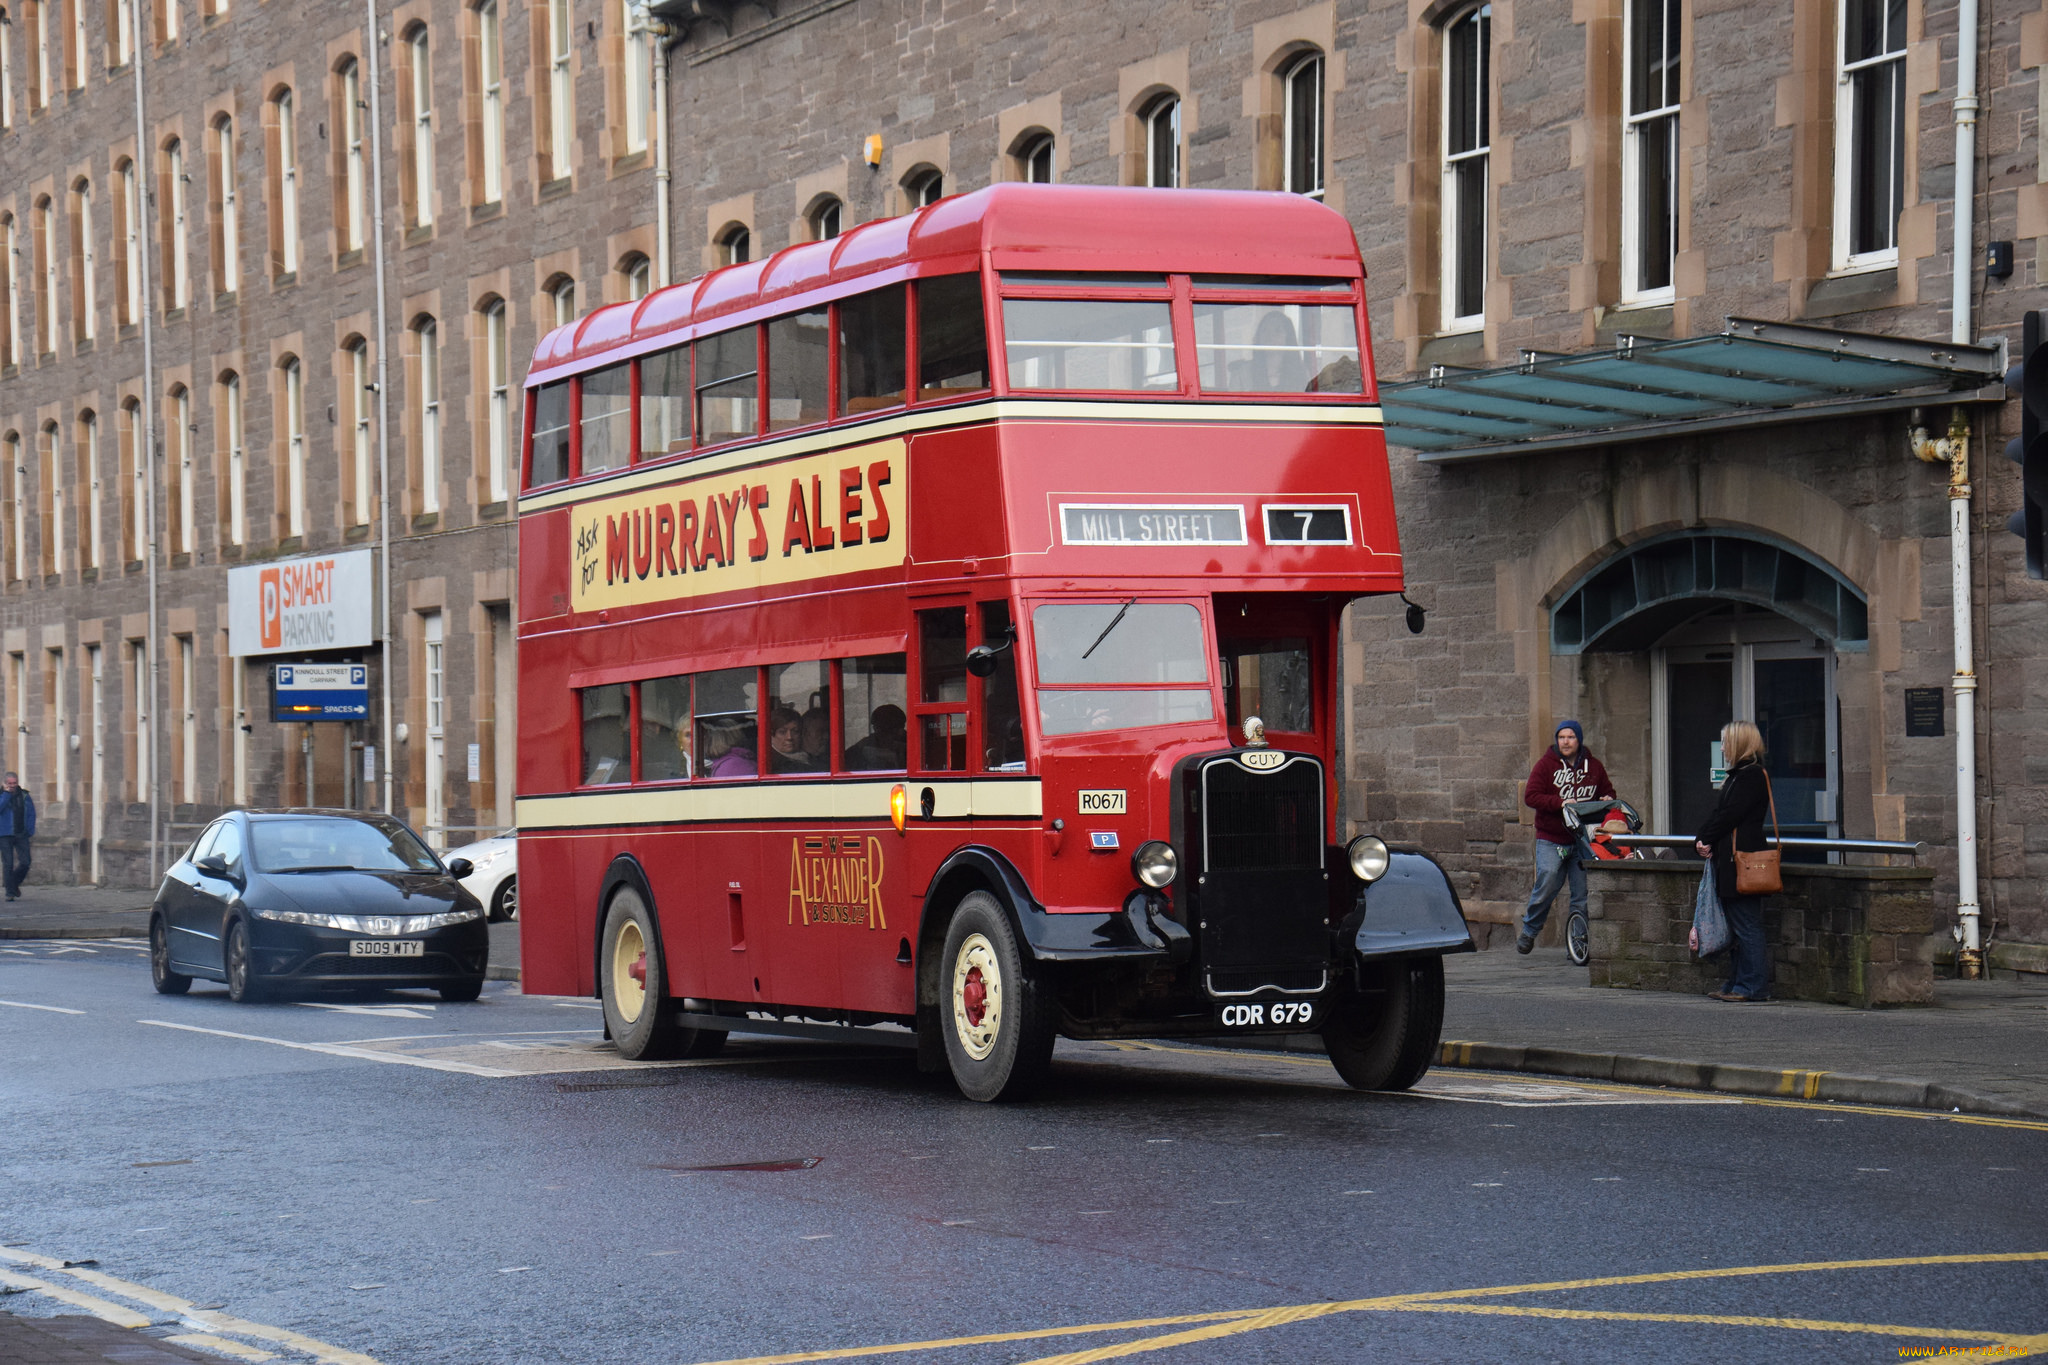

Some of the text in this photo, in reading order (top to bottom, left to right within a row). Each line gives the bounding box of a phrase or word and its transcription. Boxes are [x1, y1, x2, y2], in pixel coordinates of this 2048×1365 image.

[606, 460, 891, 586] MURRAY'S ALES
[1081, 513, 1214, 541] MILL STREET
[1293, 511, 1314, 541] 7
[576, 518, 599, 560] Ask
[283, 559, 335, 608] SMART
[581, 556, 597, 596] for
[283, 609, 335, 647] PARKING
[324, 705, 353, 713] SPACES
[1248, 754, 1278, 766] GUY
[1553, 767, 1574, 788] Life
[1101, 835, 1109, 845] P
[788, 836, 887, 930] ALEXANDER
[812, 904, 820, 922] &
[356, 942, 418, 954] SD09 WTY
[1221, 1002, 1313, 1026] CDR 679
